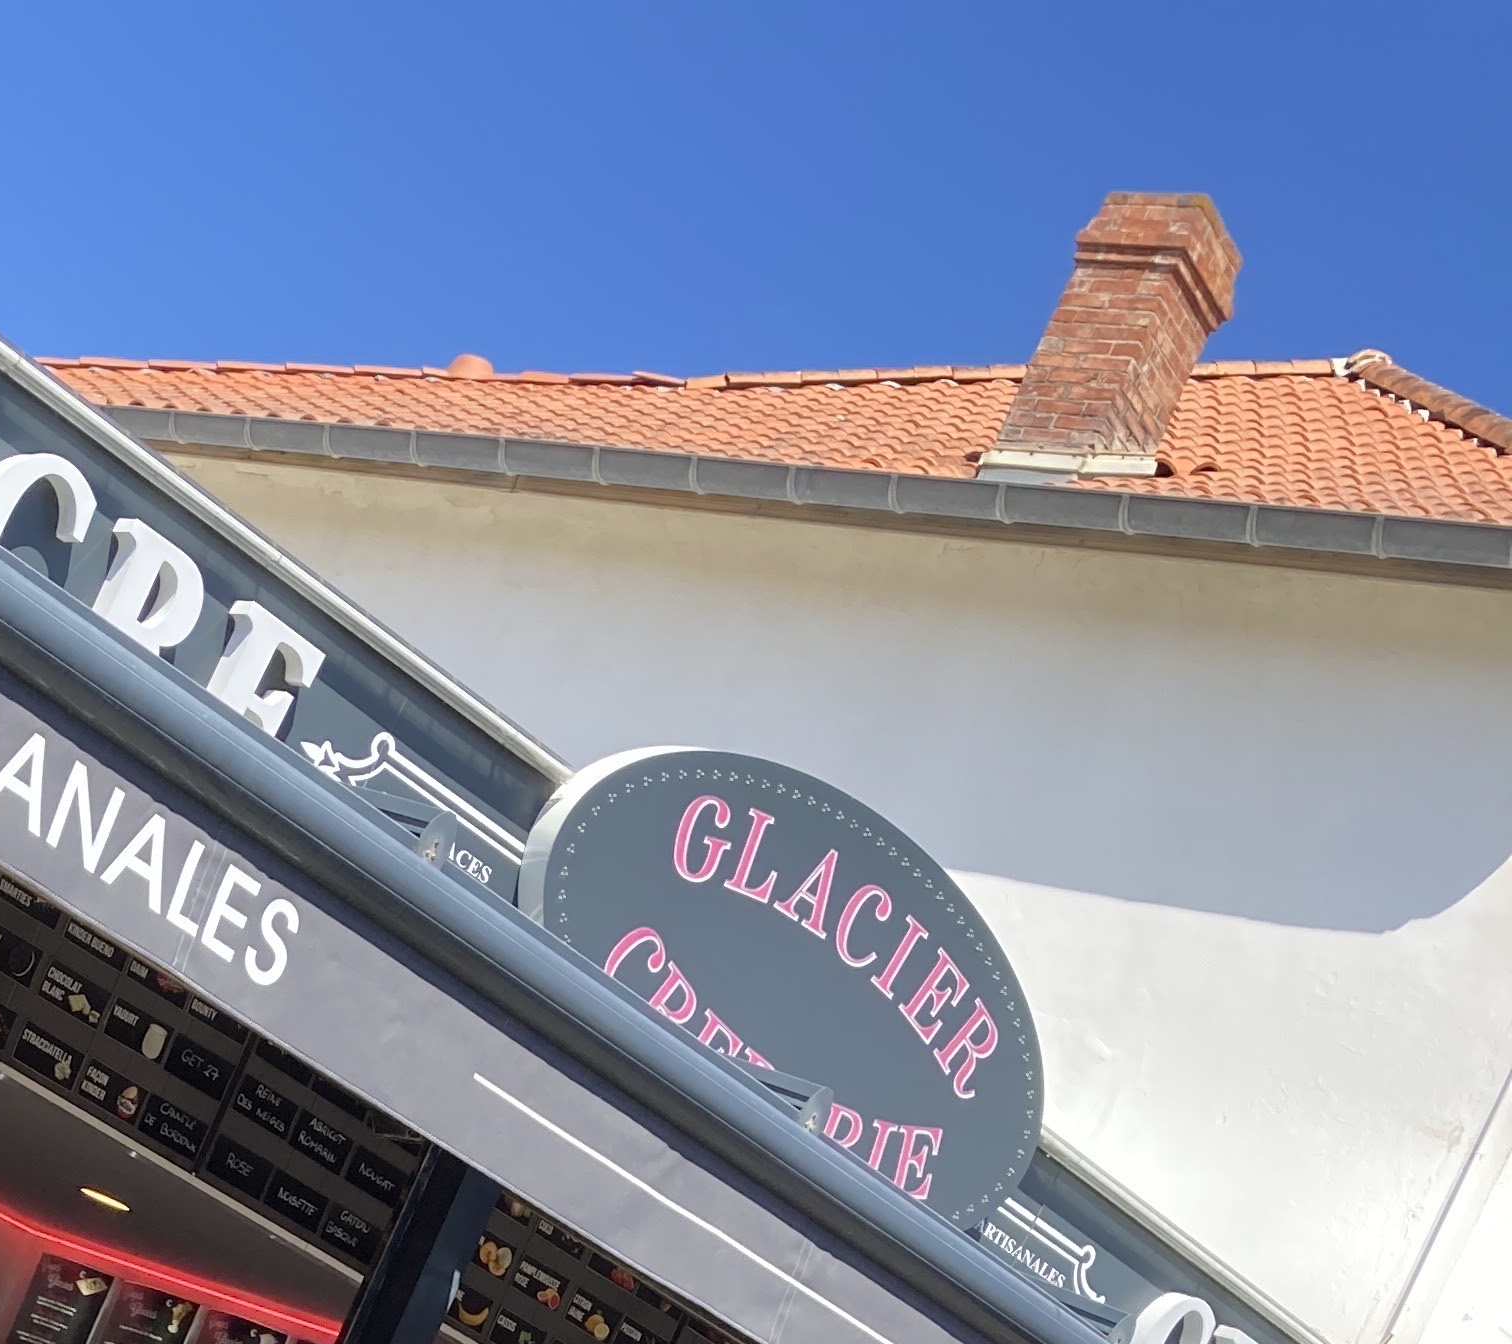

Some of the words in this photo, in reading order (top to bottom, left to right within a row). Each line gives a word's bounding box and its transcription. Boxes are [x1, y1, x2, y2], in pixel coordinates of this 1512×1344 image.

[67, 921, 91, 945] KINDER
[90, 938, 115, 958] BUENO
[672, 794, 998, 1099] GLACIER
[47, 966, 83, 994] CHOCOLAT
[129, 961, 149, 979] DAIM
[41, 980, 66, 1002] BLANC
[604, 926, 943, 1200] CRERIE
[255, 1083, 282, 1107] REINE
[236, 1093, 253, 1111] DES
[255, 1107, 286, 1133] NEIGES
[309, 1118, 347, 1145] ABRICOT
[297, 1130, 338, 1164] ROMARIN
[226, 1152, 254, 1178] ROSE
[358, 1162, 395, 1192] NOUGAT
[277, 1186, 319, 1217] NOISETTE
[325, 1221, 359, 1248] BASQUE
[974, 1219, 1066, 1288] ARTISANALES
